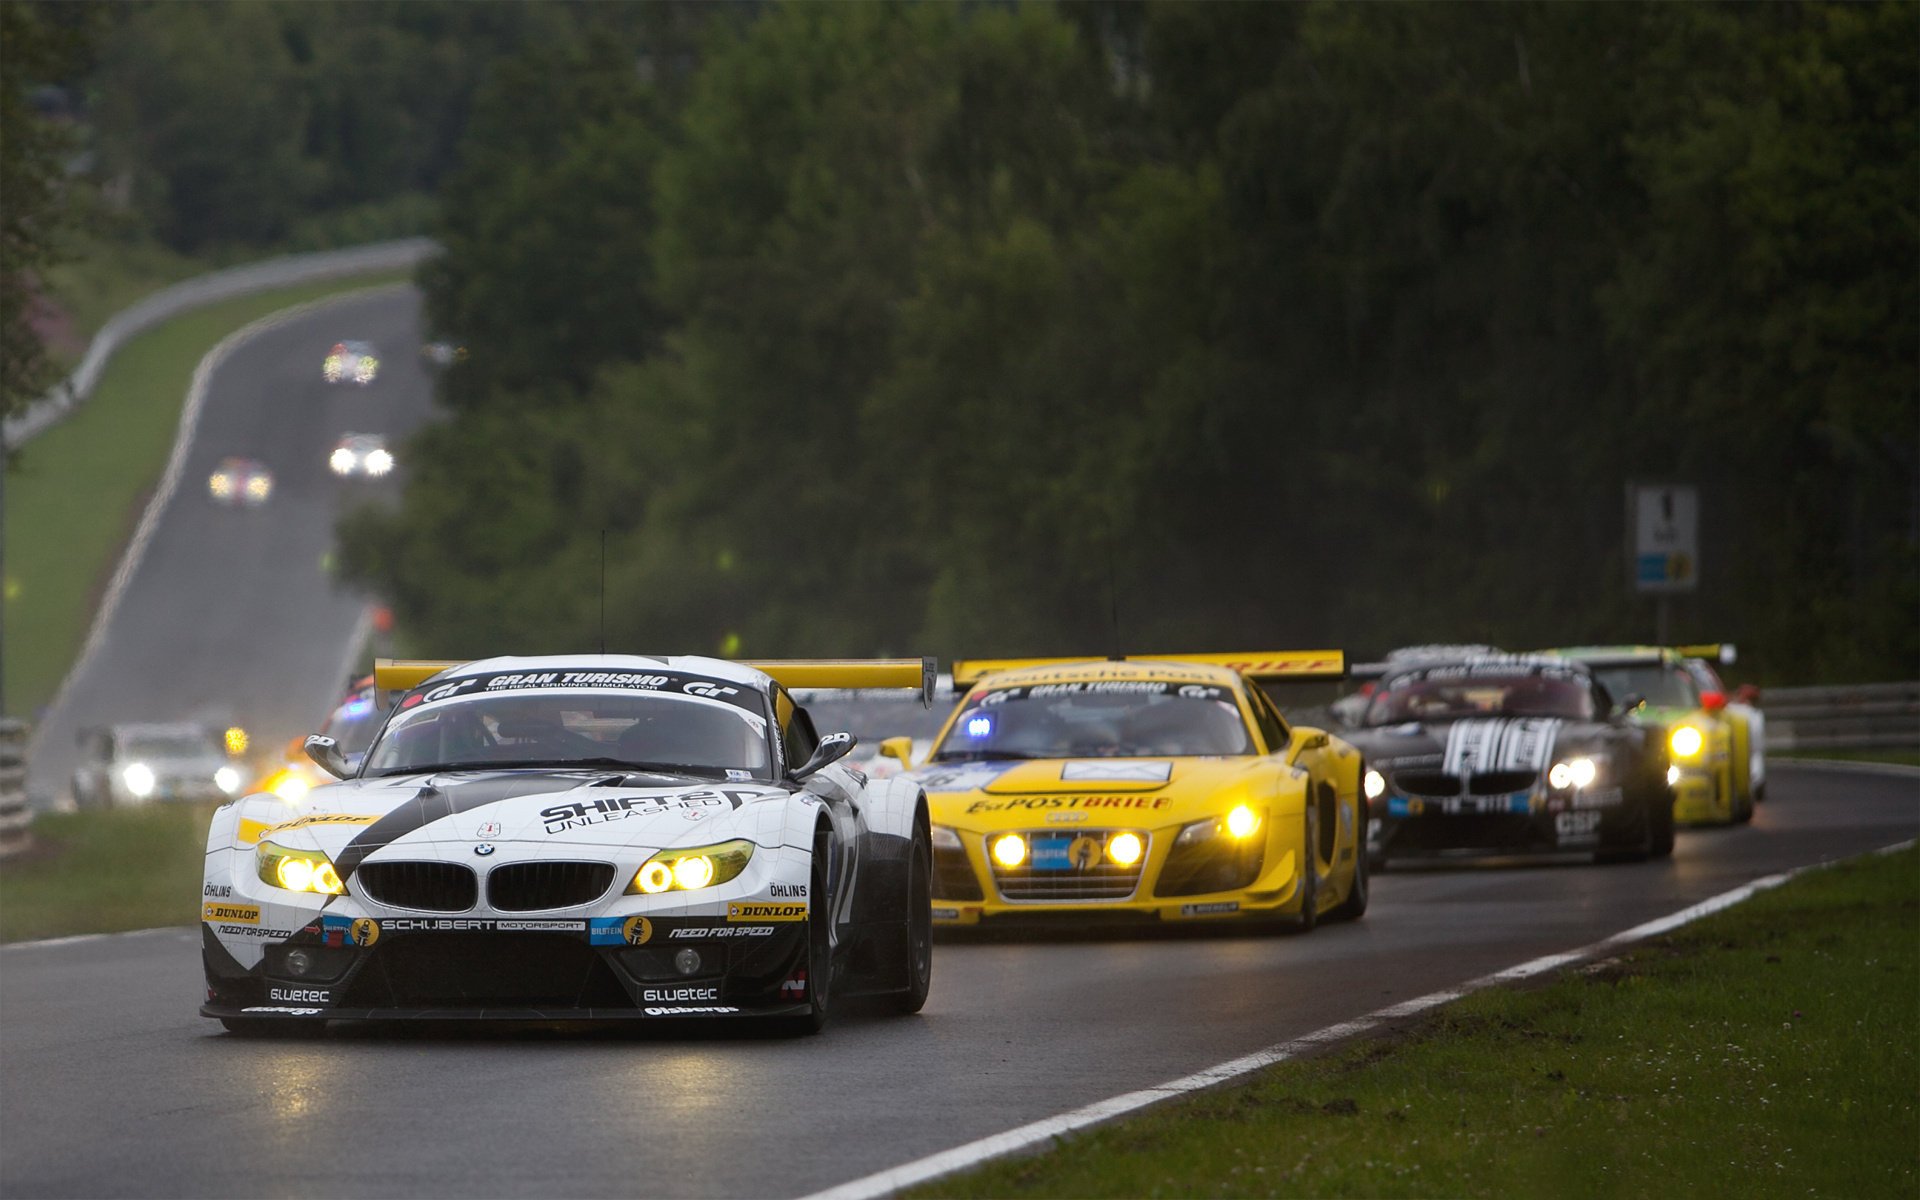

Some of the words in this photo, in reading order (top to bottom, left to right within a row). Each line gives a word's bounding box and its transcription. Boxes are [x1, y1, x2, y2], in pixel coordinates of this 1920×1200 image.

[488, 673, 558, 687] GRAN
[562, 672, 668, 686] TURISMO
[1149, 669, 1217, 681] Post
[590, 682, 658, 691] SIMULATOR
[540, 796, 674, 824] SHIFT
[544, 800, 722, 834] UNLEASHED
[204, 882, 231, 898] ÖHLINS
[769, 882, 807, 897] ÖHLINS
[215, 907, 259, 920] DUNLOP
[741, 906, 806, 916] DUNLOP
[381, 920, 495, 930] SCHUBERT
[591, 926, 622, 935] BILSTEIN
[669, 928, 708, 938] NEED
[708, 927, 735, 937] FOR
[734, 926, 775, 937] SPEED
